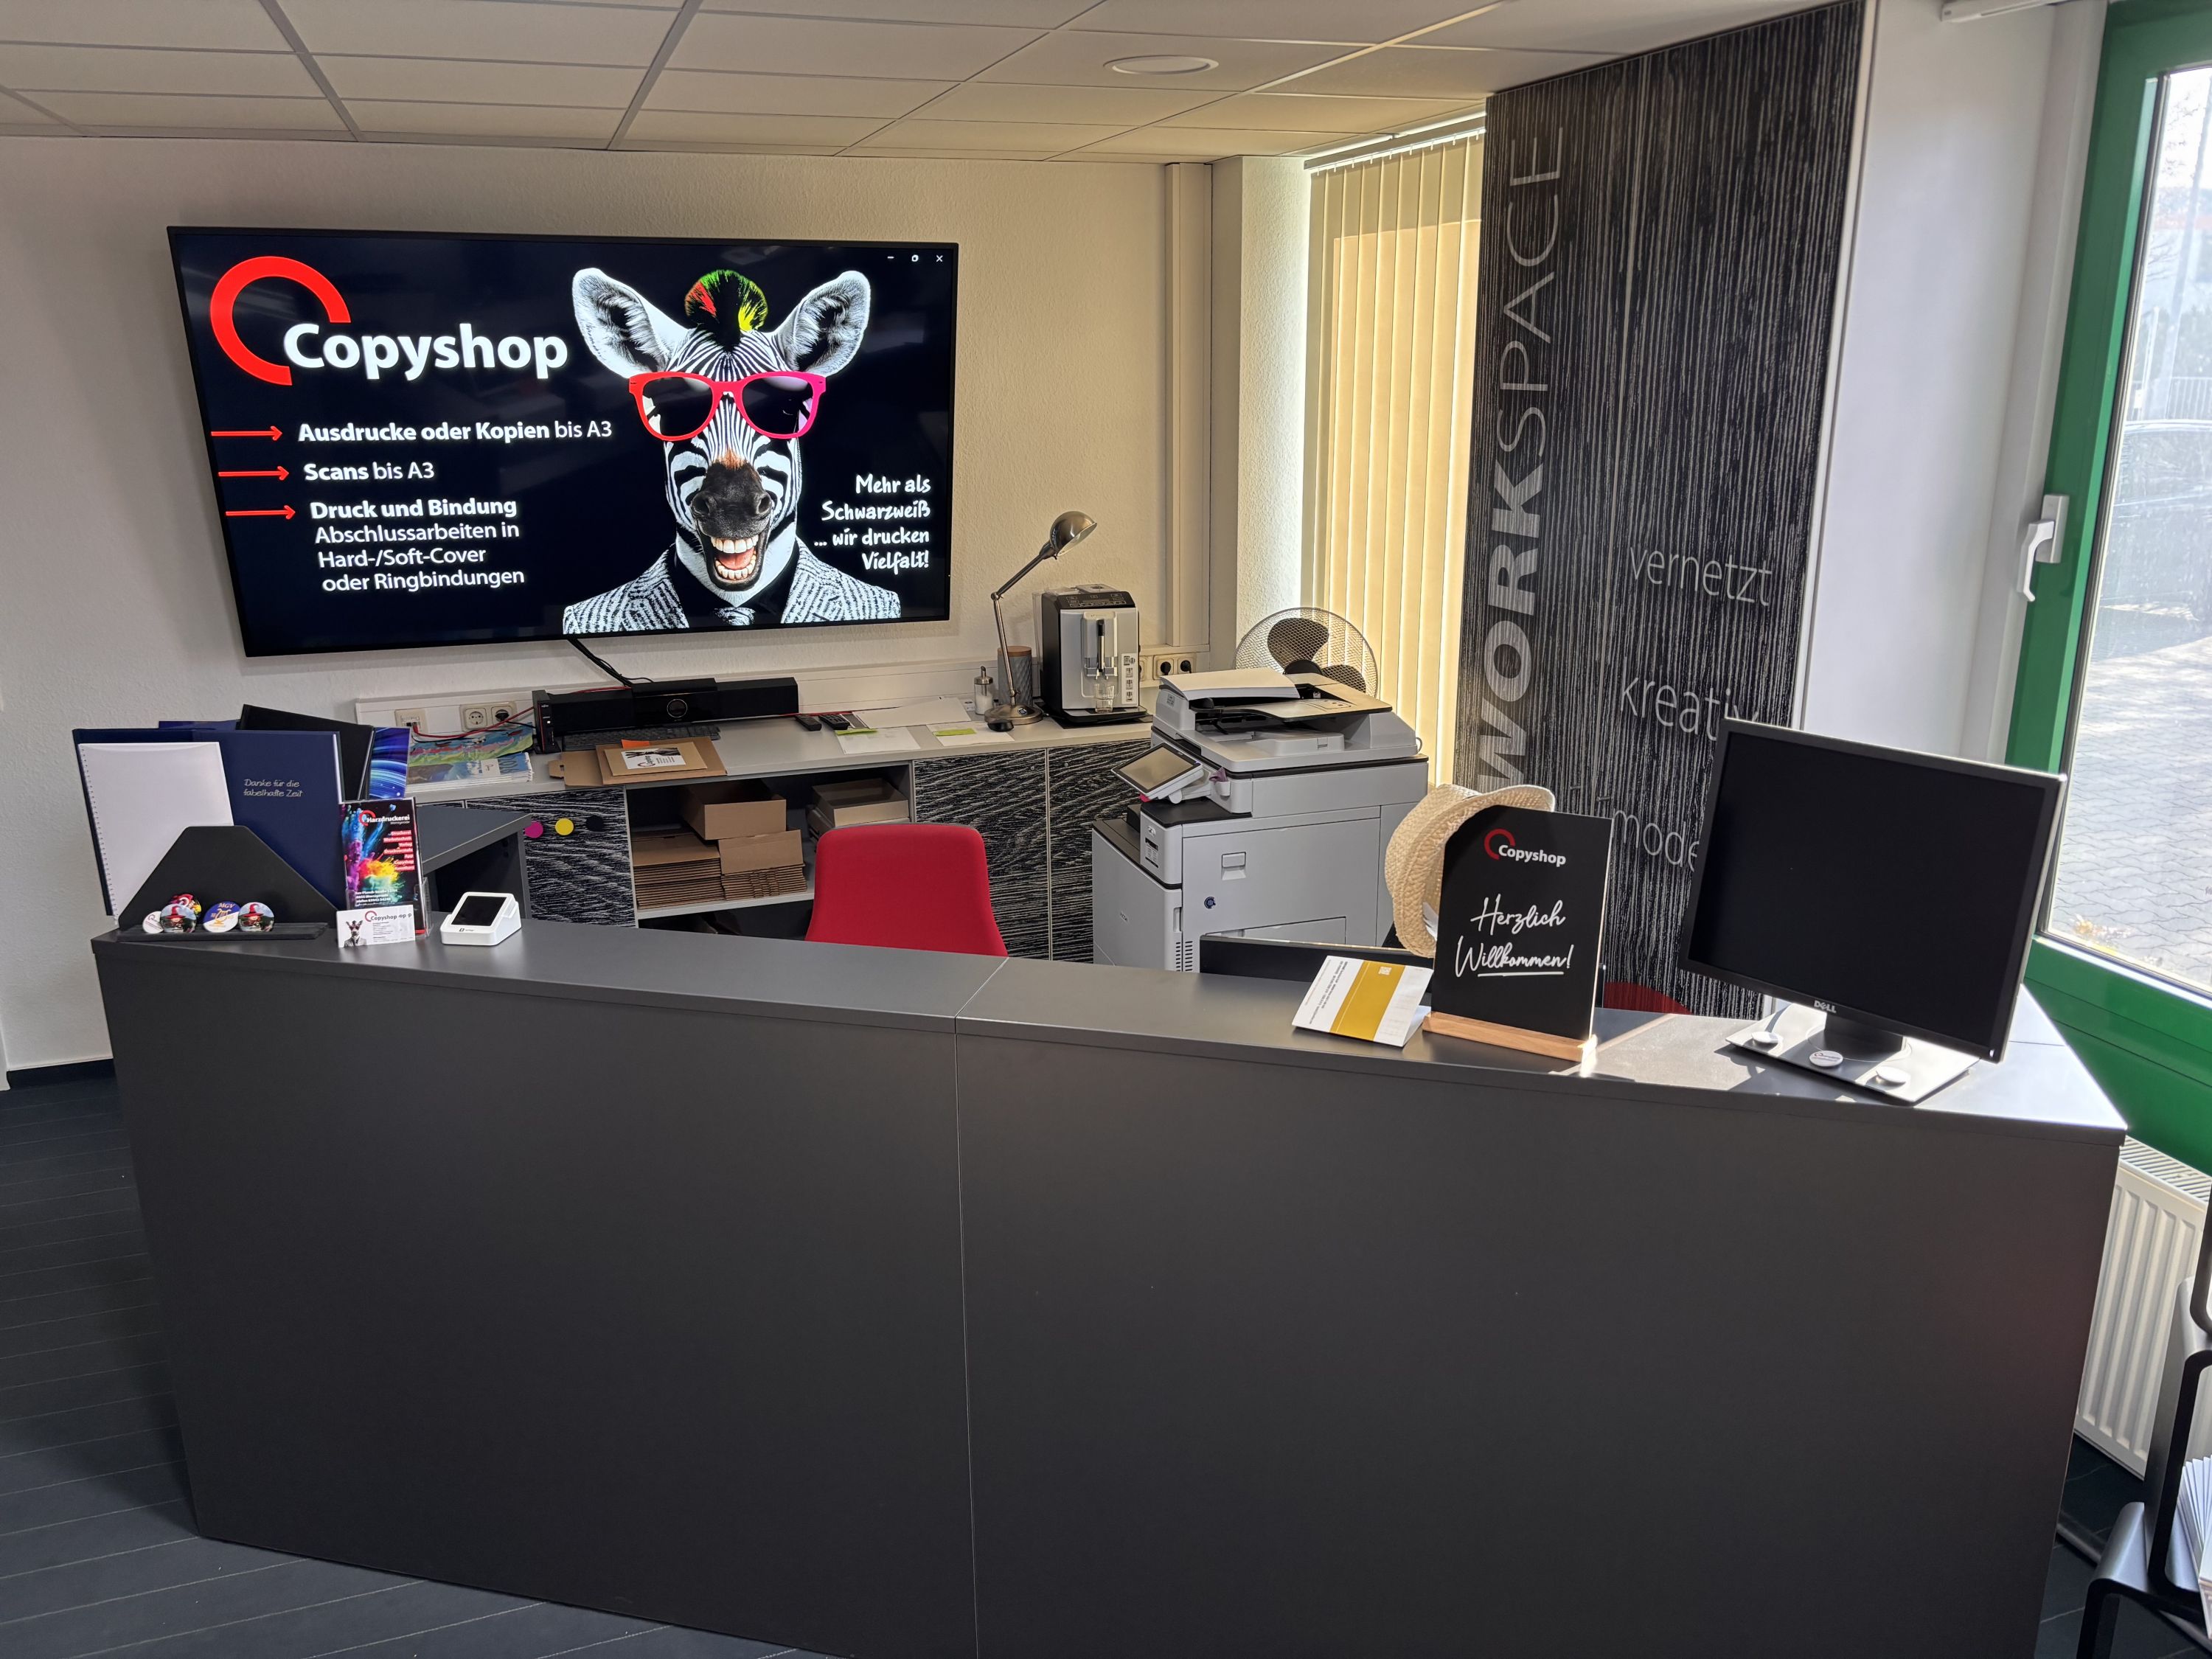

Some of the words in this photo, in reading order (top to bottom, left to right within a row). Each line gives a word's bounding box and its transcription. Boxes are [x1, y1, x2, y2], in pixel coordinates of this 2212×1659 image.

[283, 323, 568, 380] Copyshop
[298, 423, 417, 442] Ausdrucke
[421, 423, 470, 440] oder
[476, 422, 549, 443] Kopien
[554, 420, 582, 439] bis
[587, 421, 612, 438] A3
[304, 463, 369, 481] Scans
[373, 462, 403, 480] bis
[407, 462, 434, 479] A3
[855, 474, 900, 494] Mehr
[905, 474, 931, 493] als
[310, 501, 378, 519] Druck
[382, 500, 423, 518] und
[428, 498, 517, 517] Bindung
[821, 499, 931, 521] Schwarzweiß
[315, 524, 496, 544] Abschlussarbeiten
[501, 523, 520, 538] in
[832, 528, 858, 547] wir
[862, 527, 930, 546] drucken
[318, 547, 486, 568] Hard-/Soft-Cover
[862, 550, 930, 575] Vielfalt!
[321, 574, 369, 591] oder
[374, 569, 524, 591] Ringbindungen
[1630, 546, 1773, 606] vernetzt
[243, 779, 271, 787] Danke
[286, 789, 303, 797] Zeit
[366, 815, 410, 823] Harzdruckerei
[1498, 844, 1566, 867] Copyshop
[1470, 894, 1566, 935] Herzlich
[1455, 936, 1574, 978] Willkommen!
[1814, 1000, 1837, 1013] DELL
